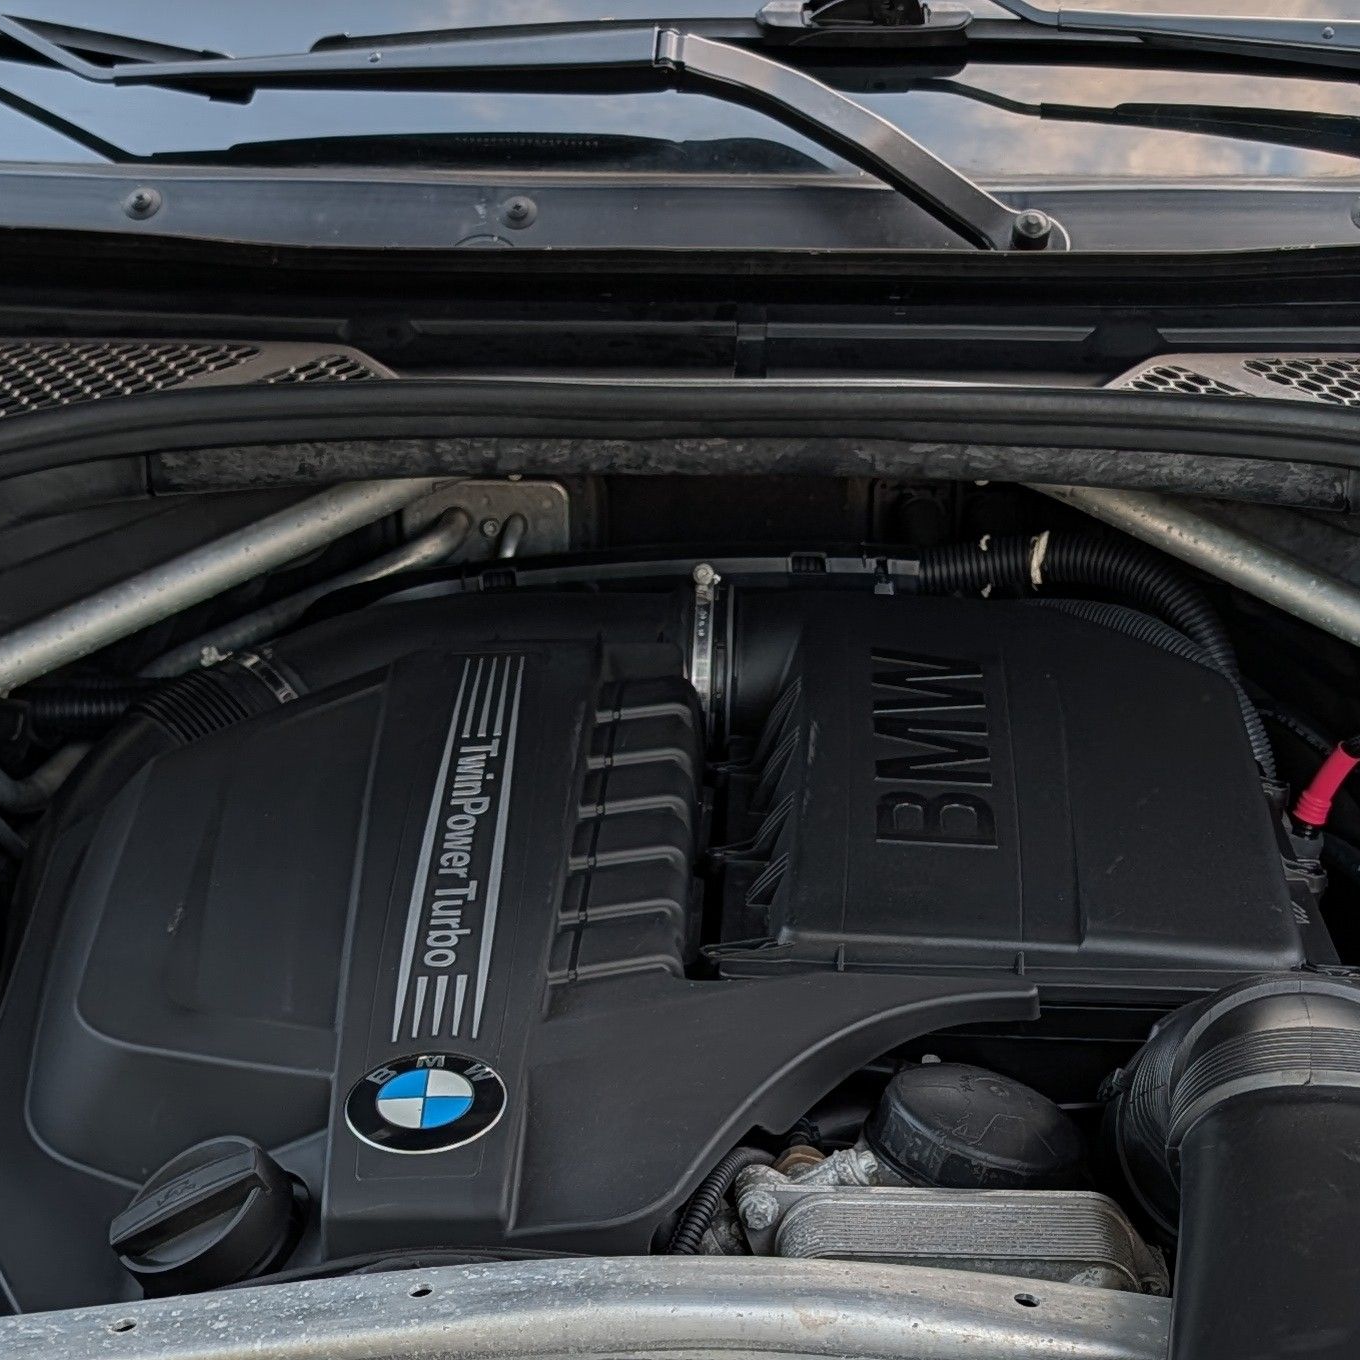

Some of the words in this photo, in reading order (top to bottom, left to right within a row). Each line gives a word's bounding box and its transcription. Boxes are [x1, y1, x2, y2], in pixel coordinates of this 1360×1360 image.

[871, 648, 998, 849] BMW
[438, 738, 500, 878] TwinPower
[423, 880, 478, 968] Turbo
[365, 1055, 495, 1085] BMW
